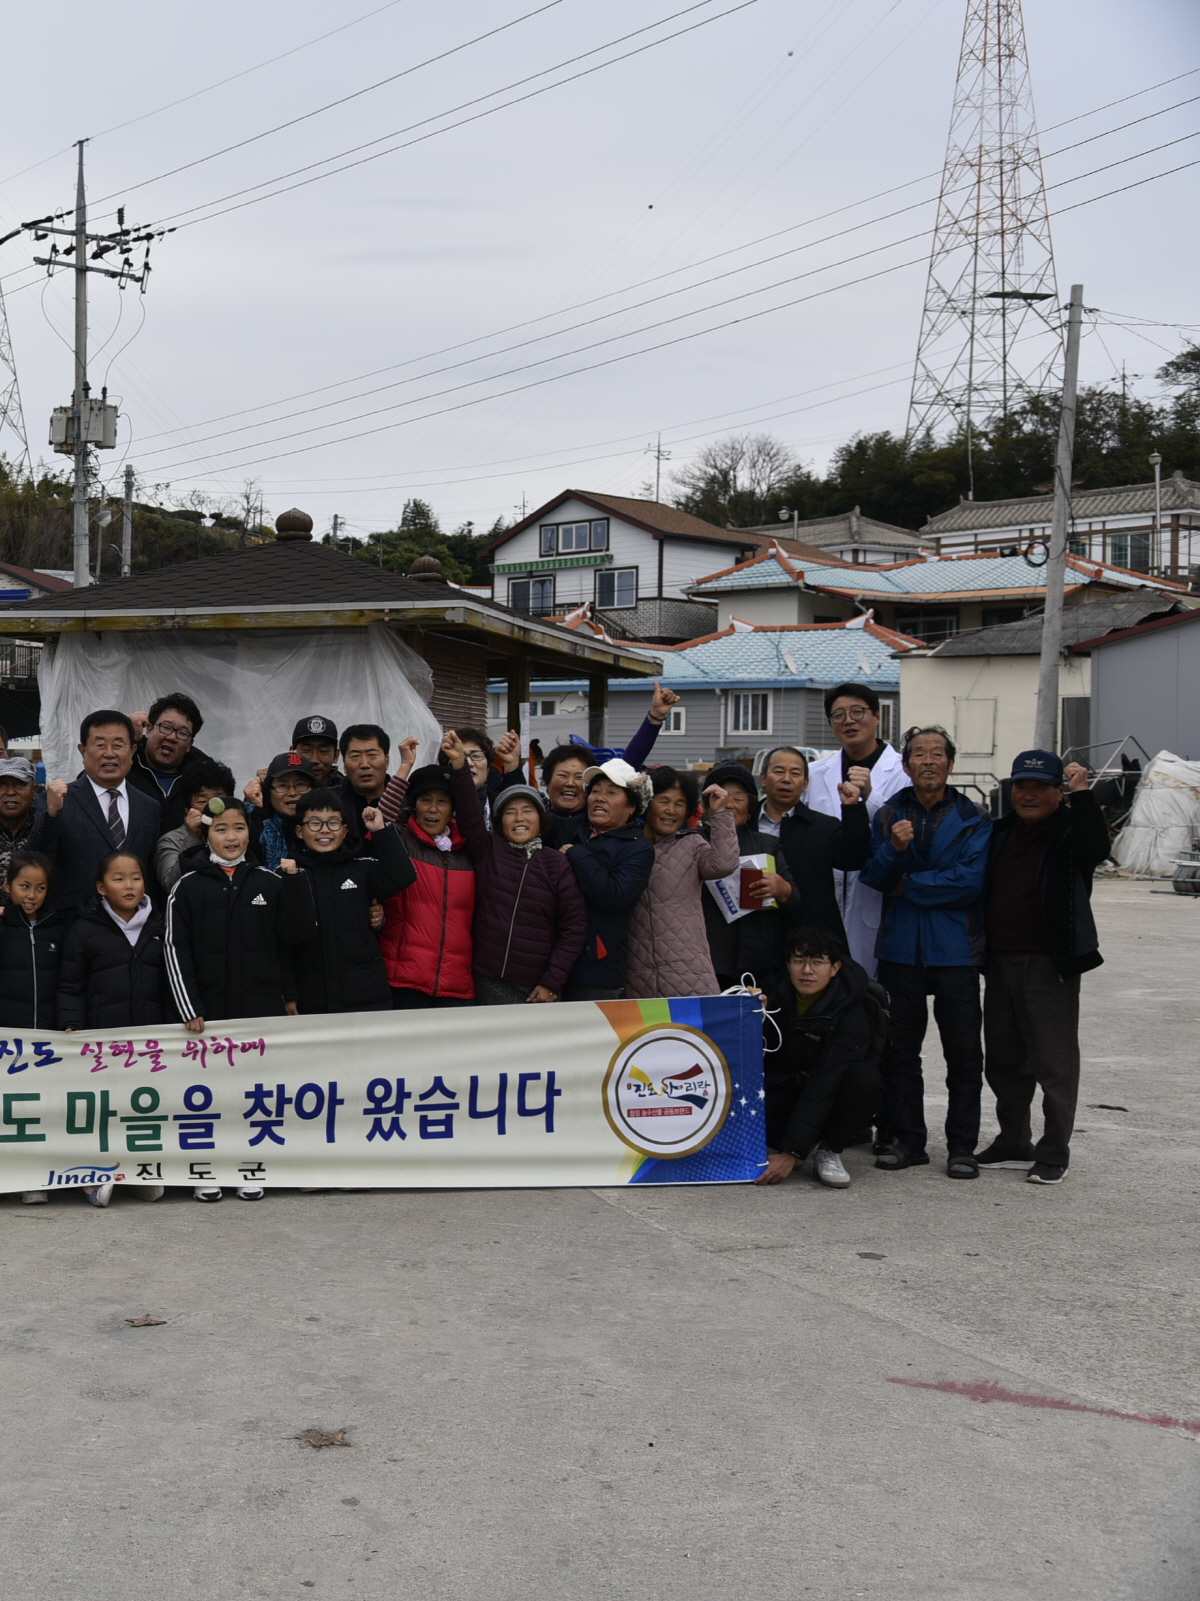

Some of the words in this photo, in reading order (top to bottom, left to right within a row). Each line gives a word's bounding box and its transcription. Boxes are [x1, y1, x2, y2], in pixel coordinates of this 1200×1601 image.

[287, 753, 303, 767] B
[80, 1039, 167, 1073] 실현을
[181, 1036, 266, 1069] 위하여
[65, 1084, 222, 1153] 마을을
[241, 1081, 345, 1147] 찾아
[362, 1070, 563, 1143] 왔습니다
[41, 1169, 112, 1187] Jindo
